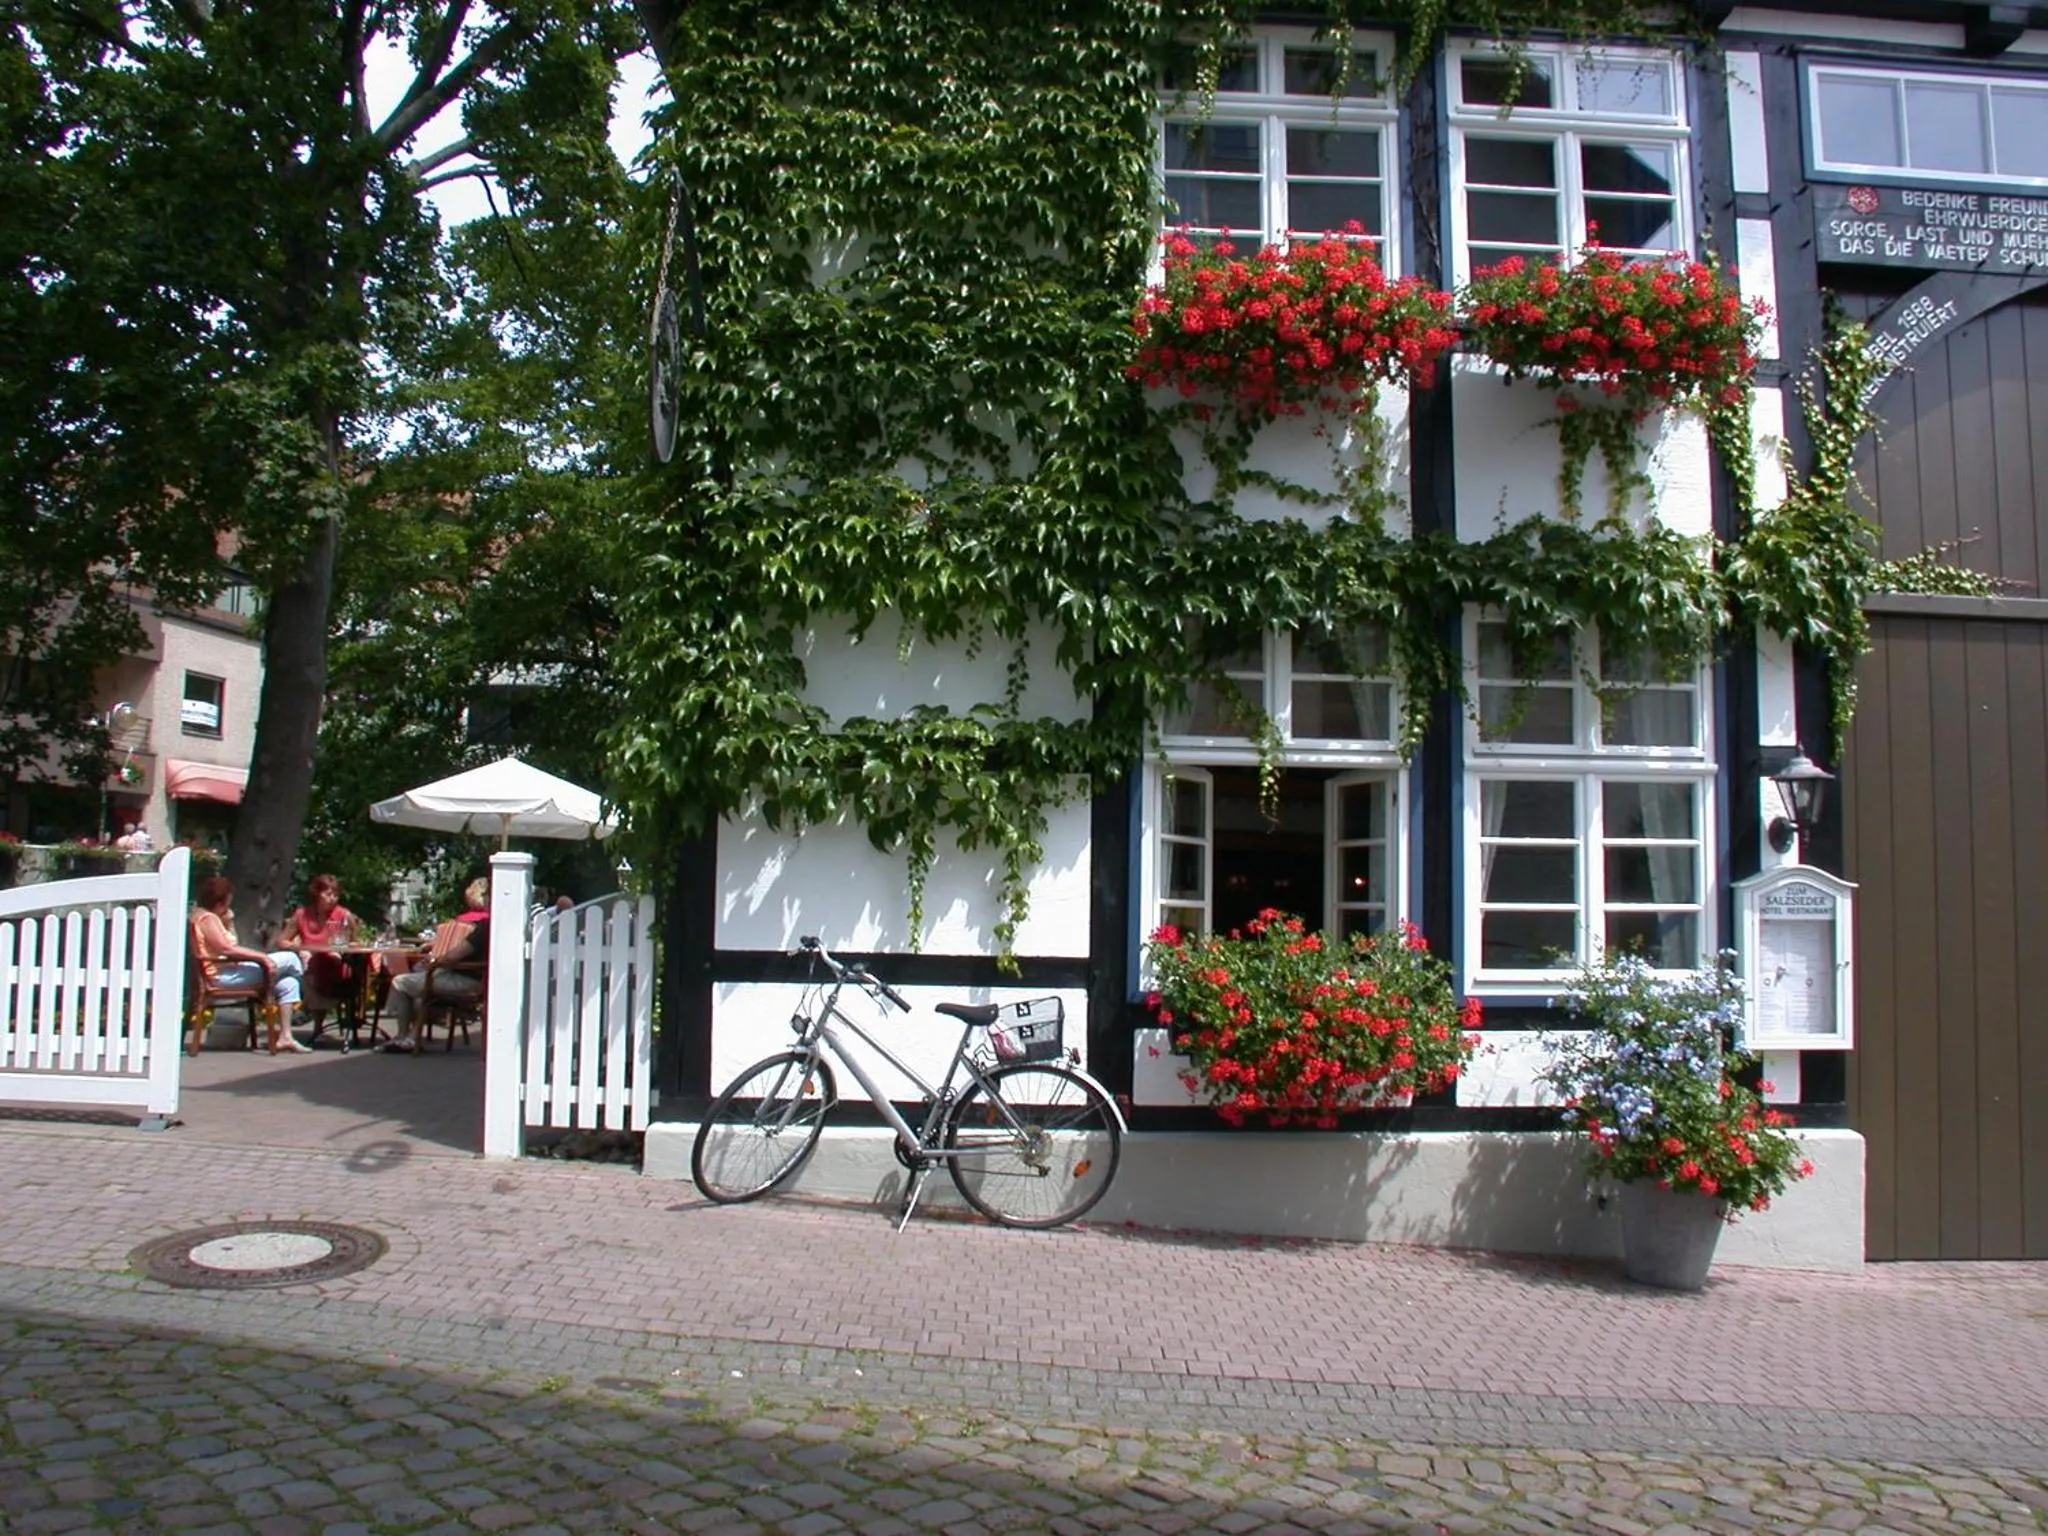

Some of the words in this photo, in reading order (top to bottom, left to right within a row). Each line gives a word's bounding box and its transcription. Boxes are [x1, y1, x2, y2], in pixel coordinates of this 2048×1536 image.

[1902, 190, 1979, 211] BEDENKE
[1905, 225, 1948, 243] LAST
[1959, 228, 1994, 246] UND
[1840, 238, 1875, 255] DAS
[1884, 240, 1913, 257] DIE
[1924, 243, 1990, 262] VAETER
[1897, 295, 1935, 329] 1988
[1766, 896, 1827, 906] SALZSIEDER
[1786, 886, 1807, 896] ZUM
